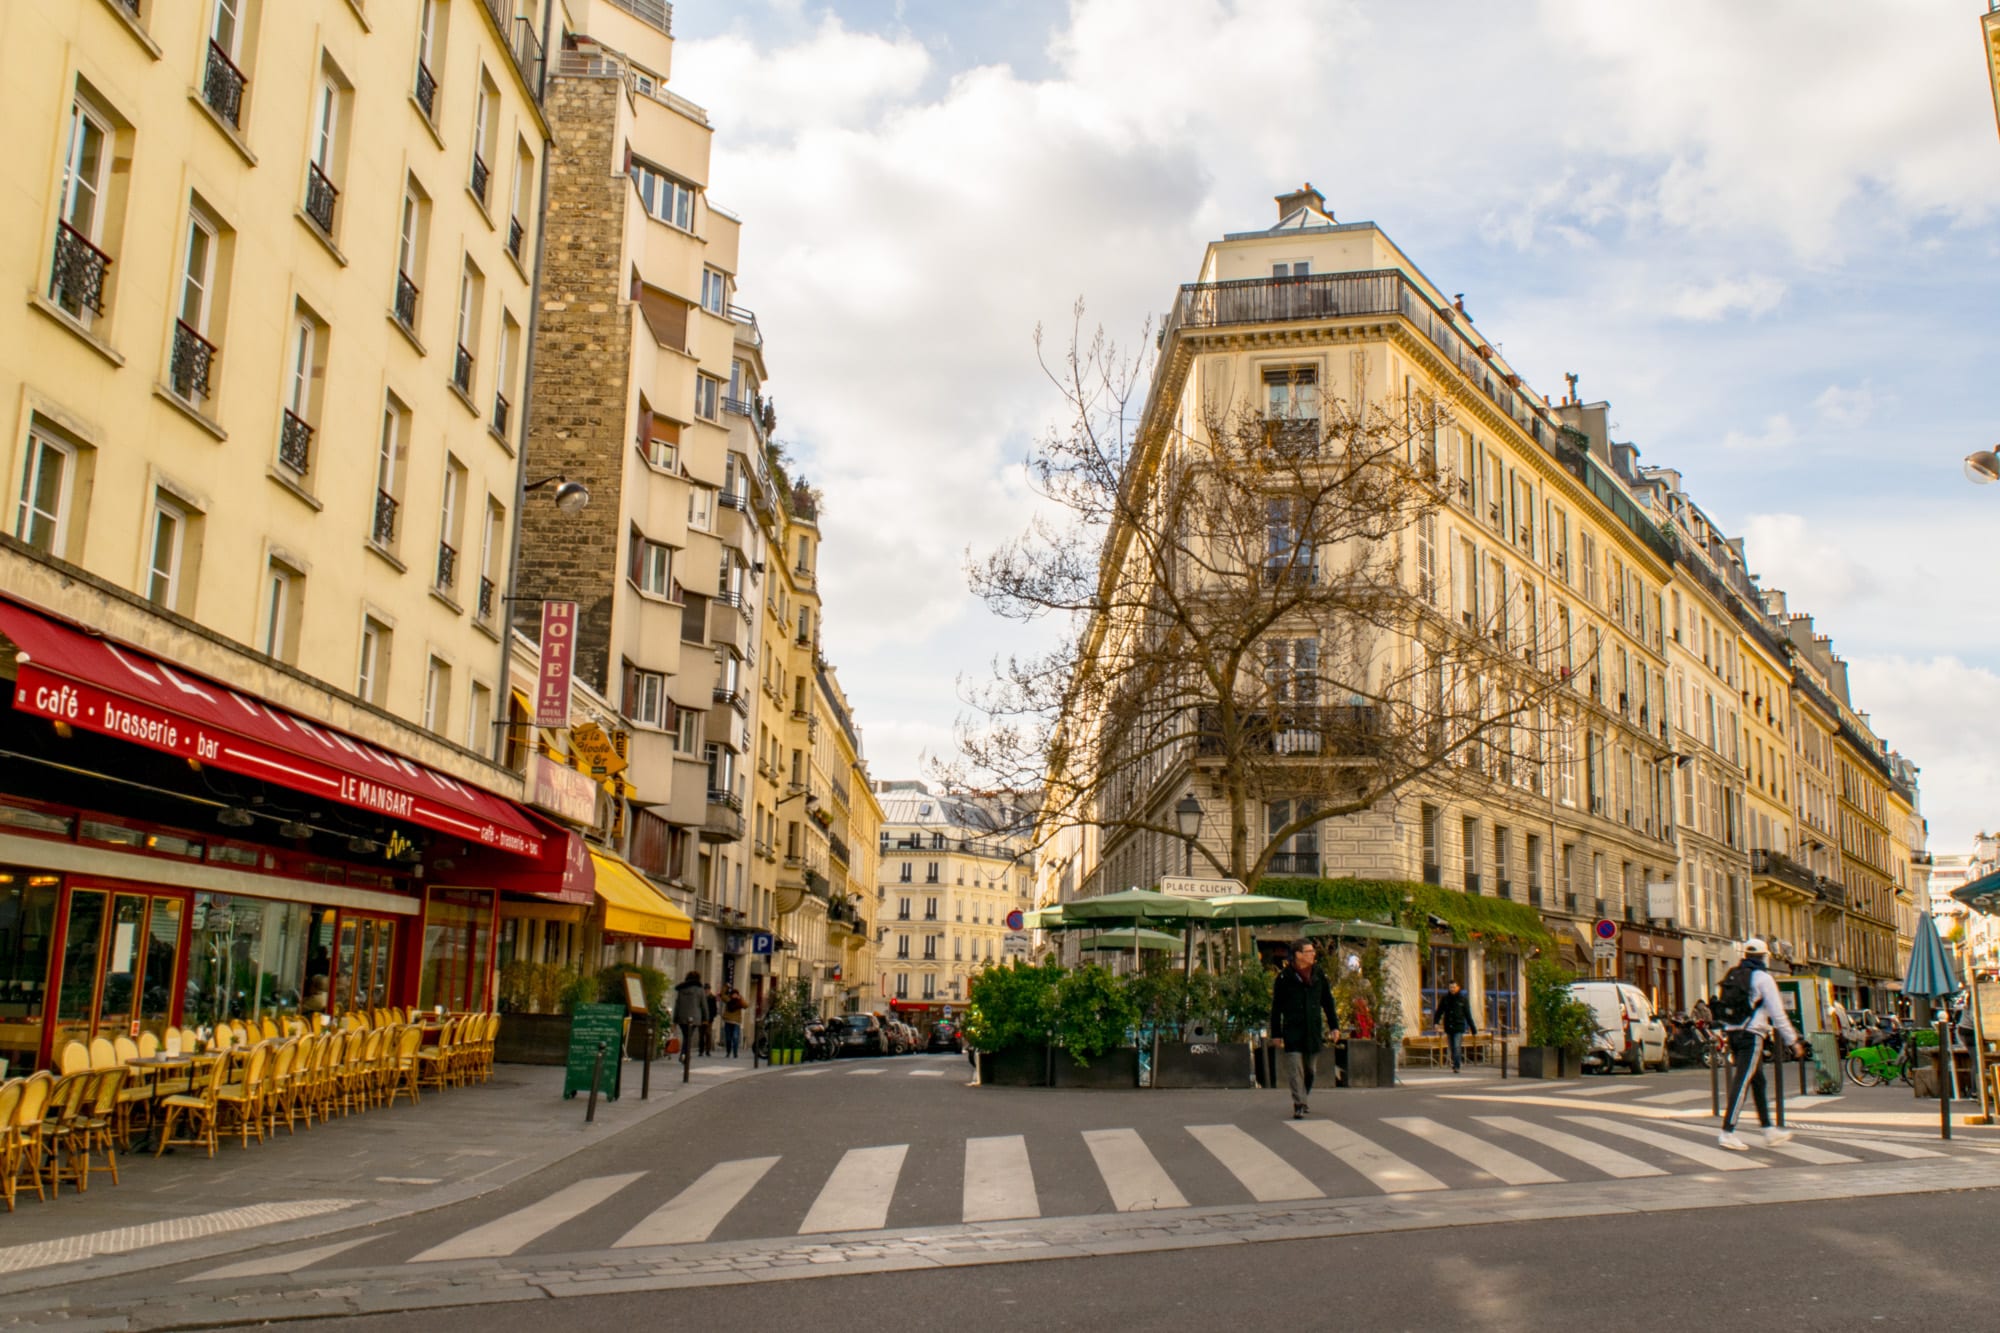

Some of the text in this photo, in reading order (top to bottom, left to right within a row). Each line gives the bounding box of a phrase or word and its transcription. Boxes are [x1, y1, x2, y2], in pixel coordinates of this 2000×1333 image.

[546, 603, 568, 697] HOTEL
[36, 685, 219, 759] café brasserie bar
[341, 775, 414, 817] LE MANSART
[1166, 882, 1233, 894] PLACE CLICHY
[757, 936, 769, 952] P
